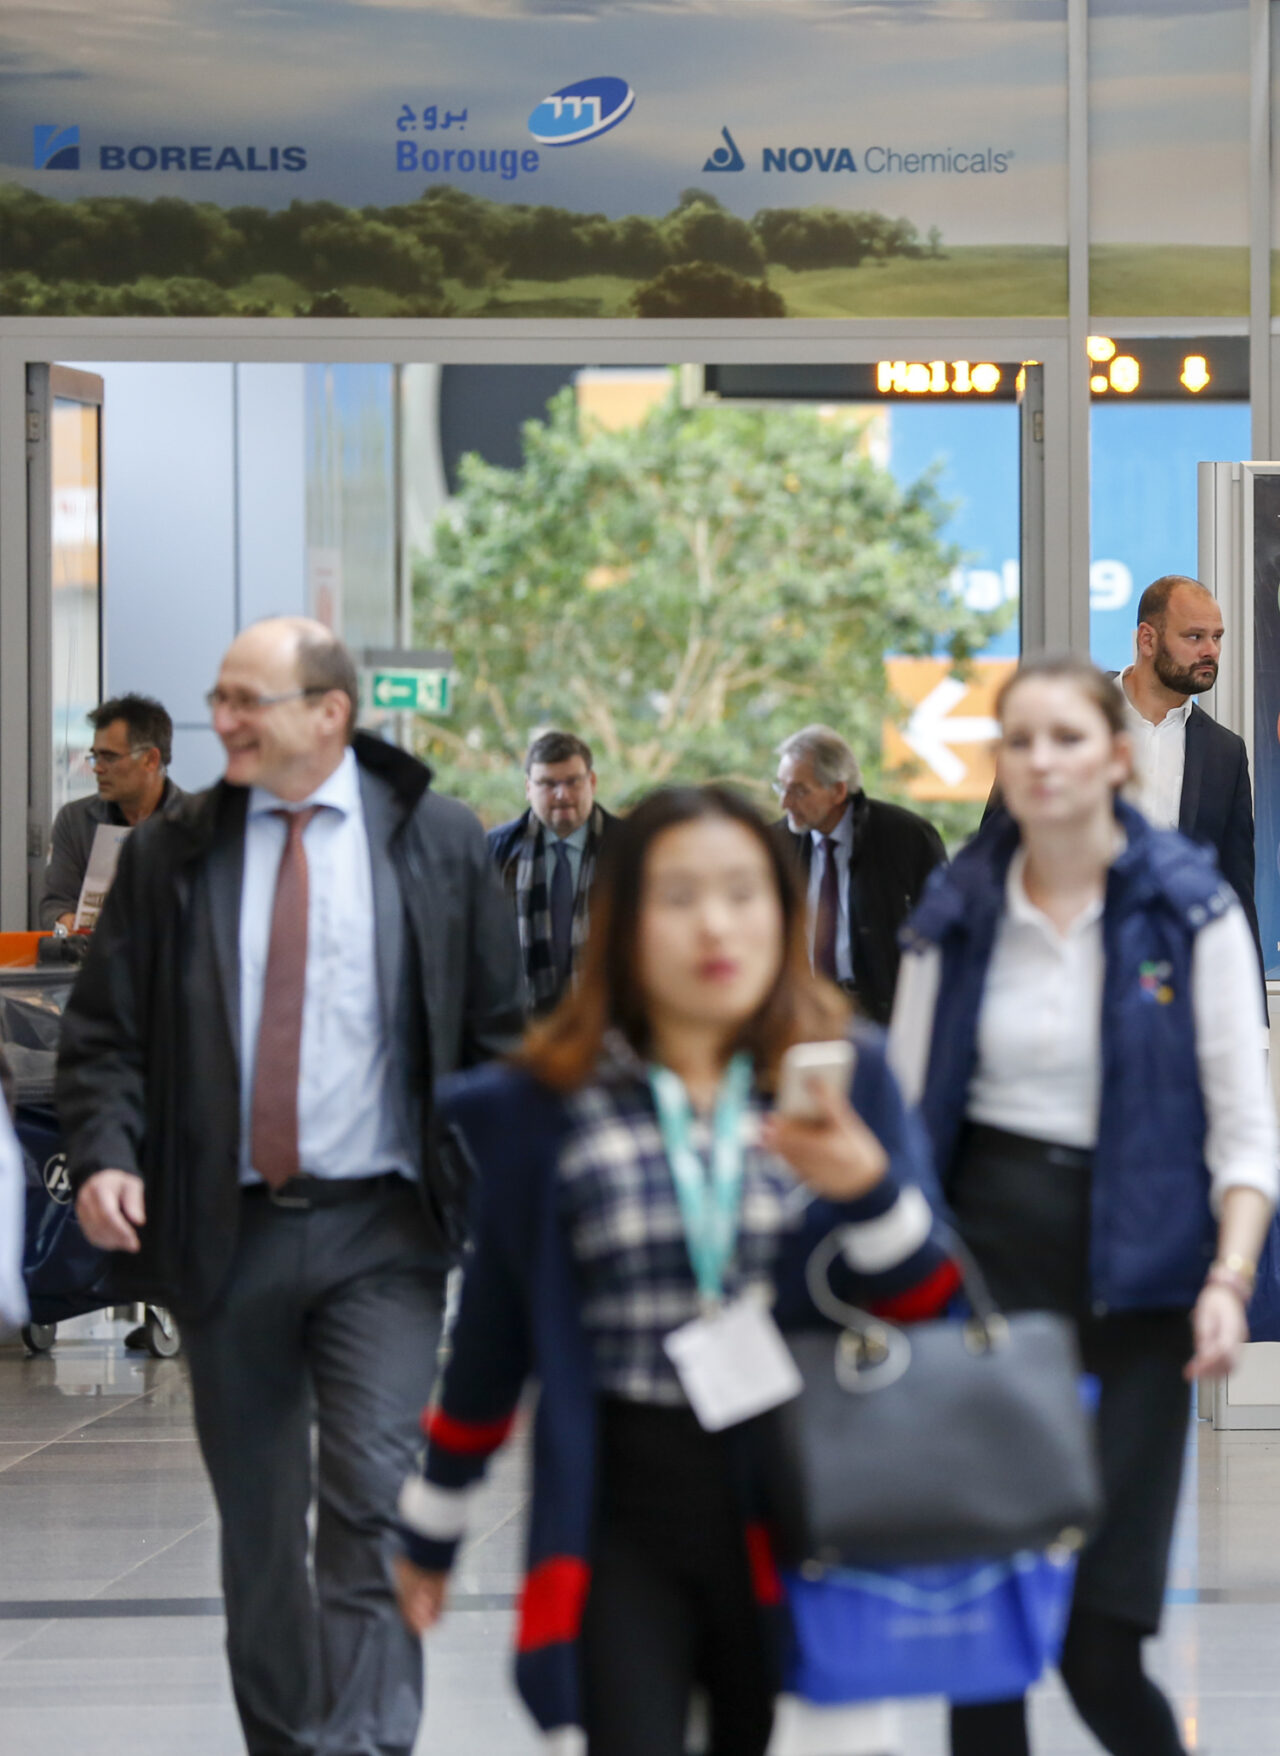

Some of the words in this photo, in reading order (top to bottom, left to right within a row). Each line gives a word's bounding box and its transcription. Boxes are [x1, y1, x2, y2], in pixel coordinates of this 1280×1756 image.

[100, 145, 307, 172] BOREALIS
[396, 140, 539, 180] Borouge
[762, 147, 858, 173] NOVA
[876, 360, 1001, 393] Halle
